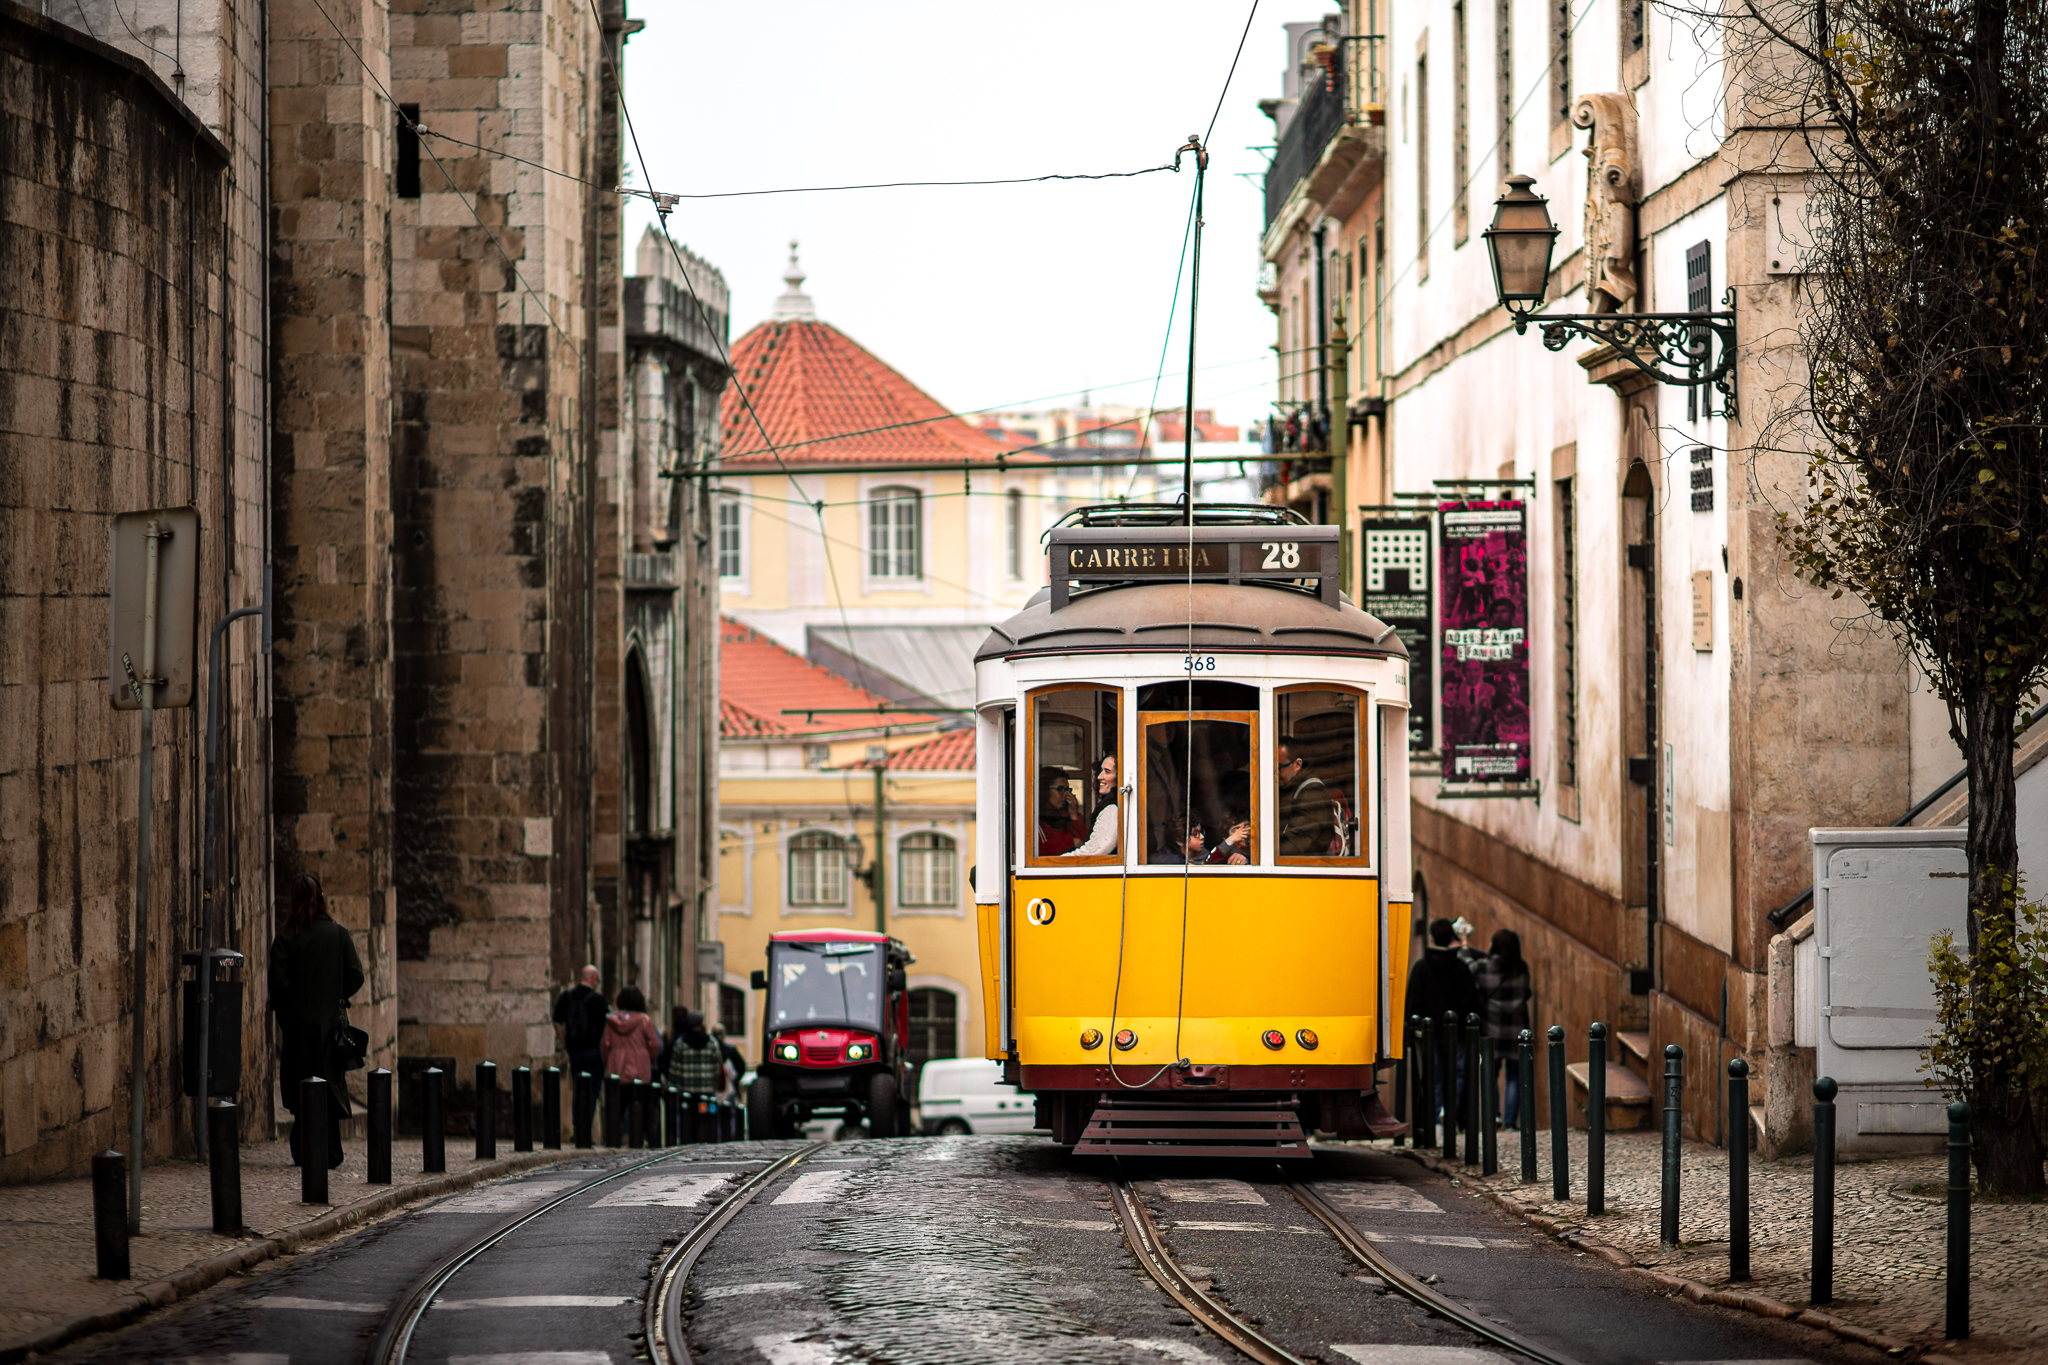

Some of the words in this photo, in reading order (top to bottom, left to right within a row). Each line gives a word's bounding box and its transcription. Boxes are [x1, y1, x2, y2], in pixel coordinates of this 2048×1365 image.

[1070, 548, 1211, 569] CARREIRA
[1261, 542, 1301, 570] 28
[1184, 656, 1216, 671] 568
